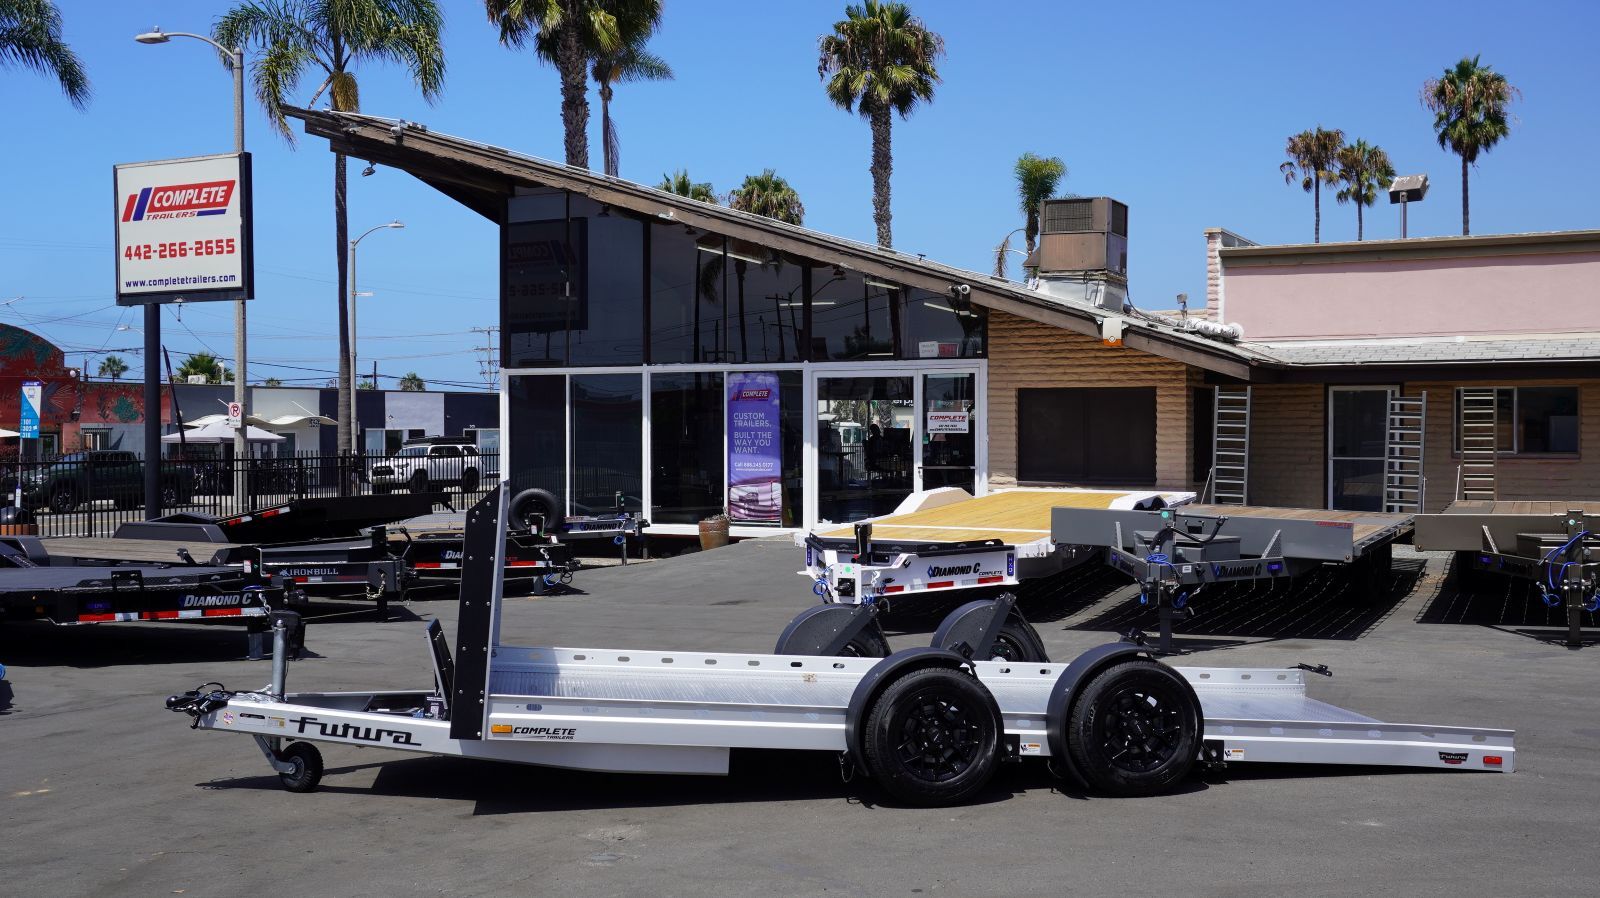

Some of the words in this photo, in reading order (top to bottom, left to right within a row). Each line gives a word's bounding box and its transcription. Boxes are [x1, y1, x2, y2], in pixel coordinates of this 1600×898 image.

[153, 186, 228, 208] COMPLETE
[146, 211, 197, 221] TRAILERS
[124, 238, 236, 261] 442-266-2655
[125, 274, 236, 288] www.completetrailers.com
[742, 390, 769, 398] COMPLETE
[733, 412, 765, 420] CUSTOM
[733, 420, 772, 428] TRAILERS.
[734, 439, 754, 447] WAY
[755, 439, 771, 447] YOU
[734, 446, 761, 454] WANT.
[289, 568, 339, 576] IRONBULL
[934, 565, 971, 577] DIAMOND
[973, 562, 981, 574] C
[1220, 565, 1254, 577] DIAMOND
[184, 594, 240, 607] DIAMOND
[242, 593, 253, 605] C
[289, 716, 422, 746] Futura
[513, 727, 577, 735] COMPLETE
